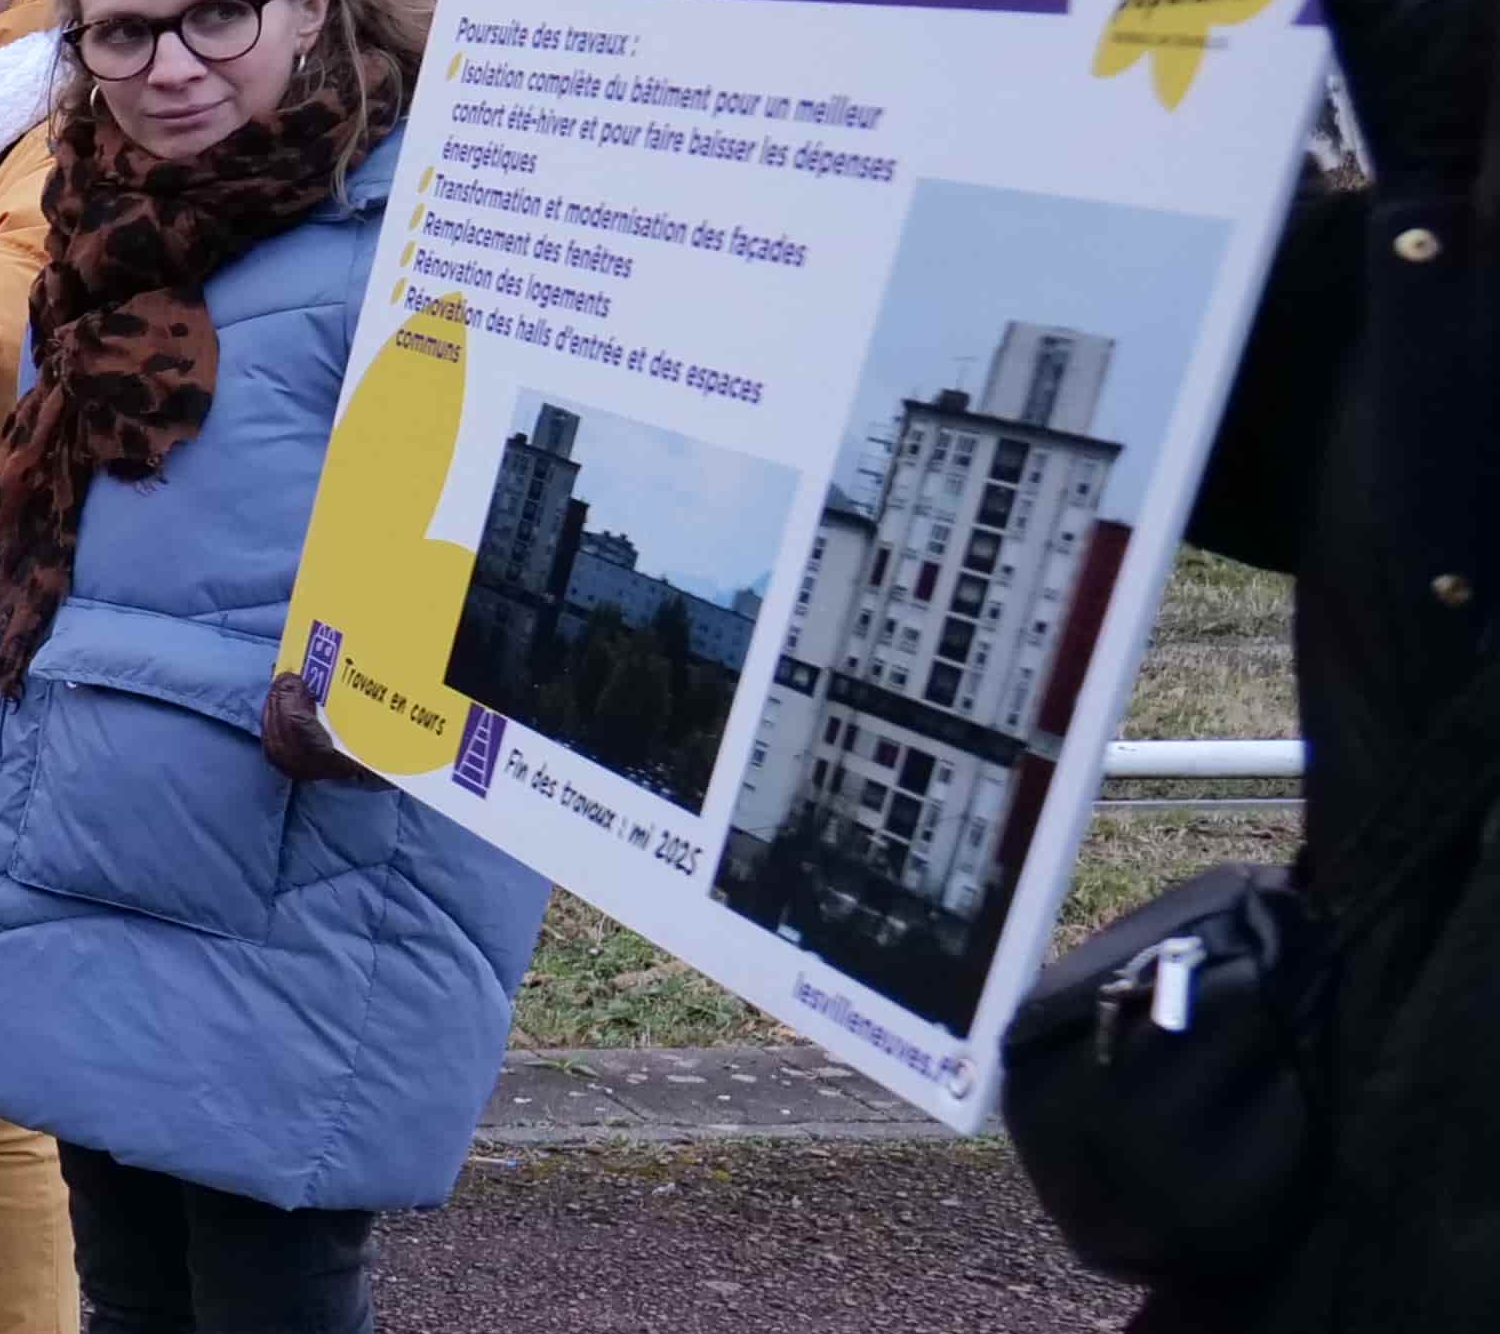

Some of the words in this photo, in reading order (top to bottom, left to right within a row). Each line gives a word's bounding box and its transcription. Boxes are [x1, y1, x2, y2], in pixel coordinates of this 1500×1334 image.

[455, 17, 528, 47] Poursuite
[531, 22, 562, 50] des
[563, 25, 629, 56] travaux
[460, 58, 524, 89] Isolation
[527, 68, 602, 100] complète
[604, 73, 627, 102] du
[630, 75, 712, 111] bâtiment
[711, 91, 762, 121] pour
[763, 95, 791, 121] un
[793, 94, 884, 130] meilleur
[441, 134, 538, 176] énergétiques
[451, 99, 505, 127] confort
[506, 103, 577, 138] été-hiver
[579, 116, 598, 142] et
[597, 123, 642, 150] pour
[644, 120, 685, 154] faire
[687, 126, 757, 163] baisser
[759, 135, 789, 168] les
[792, 139, 899, 183] dépenses
[422, 211, 531, 257] Remplacement
[533, 234, 563, 264] des
[564, 239, 633, 279] fenêtres
[433, 173, 542, 217] Transformation
[543, 195, 563, 220] et
[564, 201, 688, 245] modernisation
[691, 219, 726, 252] des
[728, 224, 807, 268] façades
[412, 248, 494, 290] Rénovation
[495, 267, 524, 297] des
[525, 274, 612, 319] logements
[395, 328, 463, 364] communs
[404, 285, 484, 330] Rénovation
[485, 307, 513, 337] des
[514, 314, 553, 348] halls
[554, 324, 624, 367] d'entrée
[626, 347, 648, 373] et
[649, 349, 683, 383] des
[685, 364, 764, 405] espaces
[341, 657, 388, 704] Travaux
[389, 690, 408, 714] en
[409, 703, 447, 736] cours
[503, 747, 528, 782] Fin
[530, 762, 558, 799] des
[560, 779, 617, 832] travaux
[627, 819, 654, 851] mi
[654, 828, 704, 876] 2025
